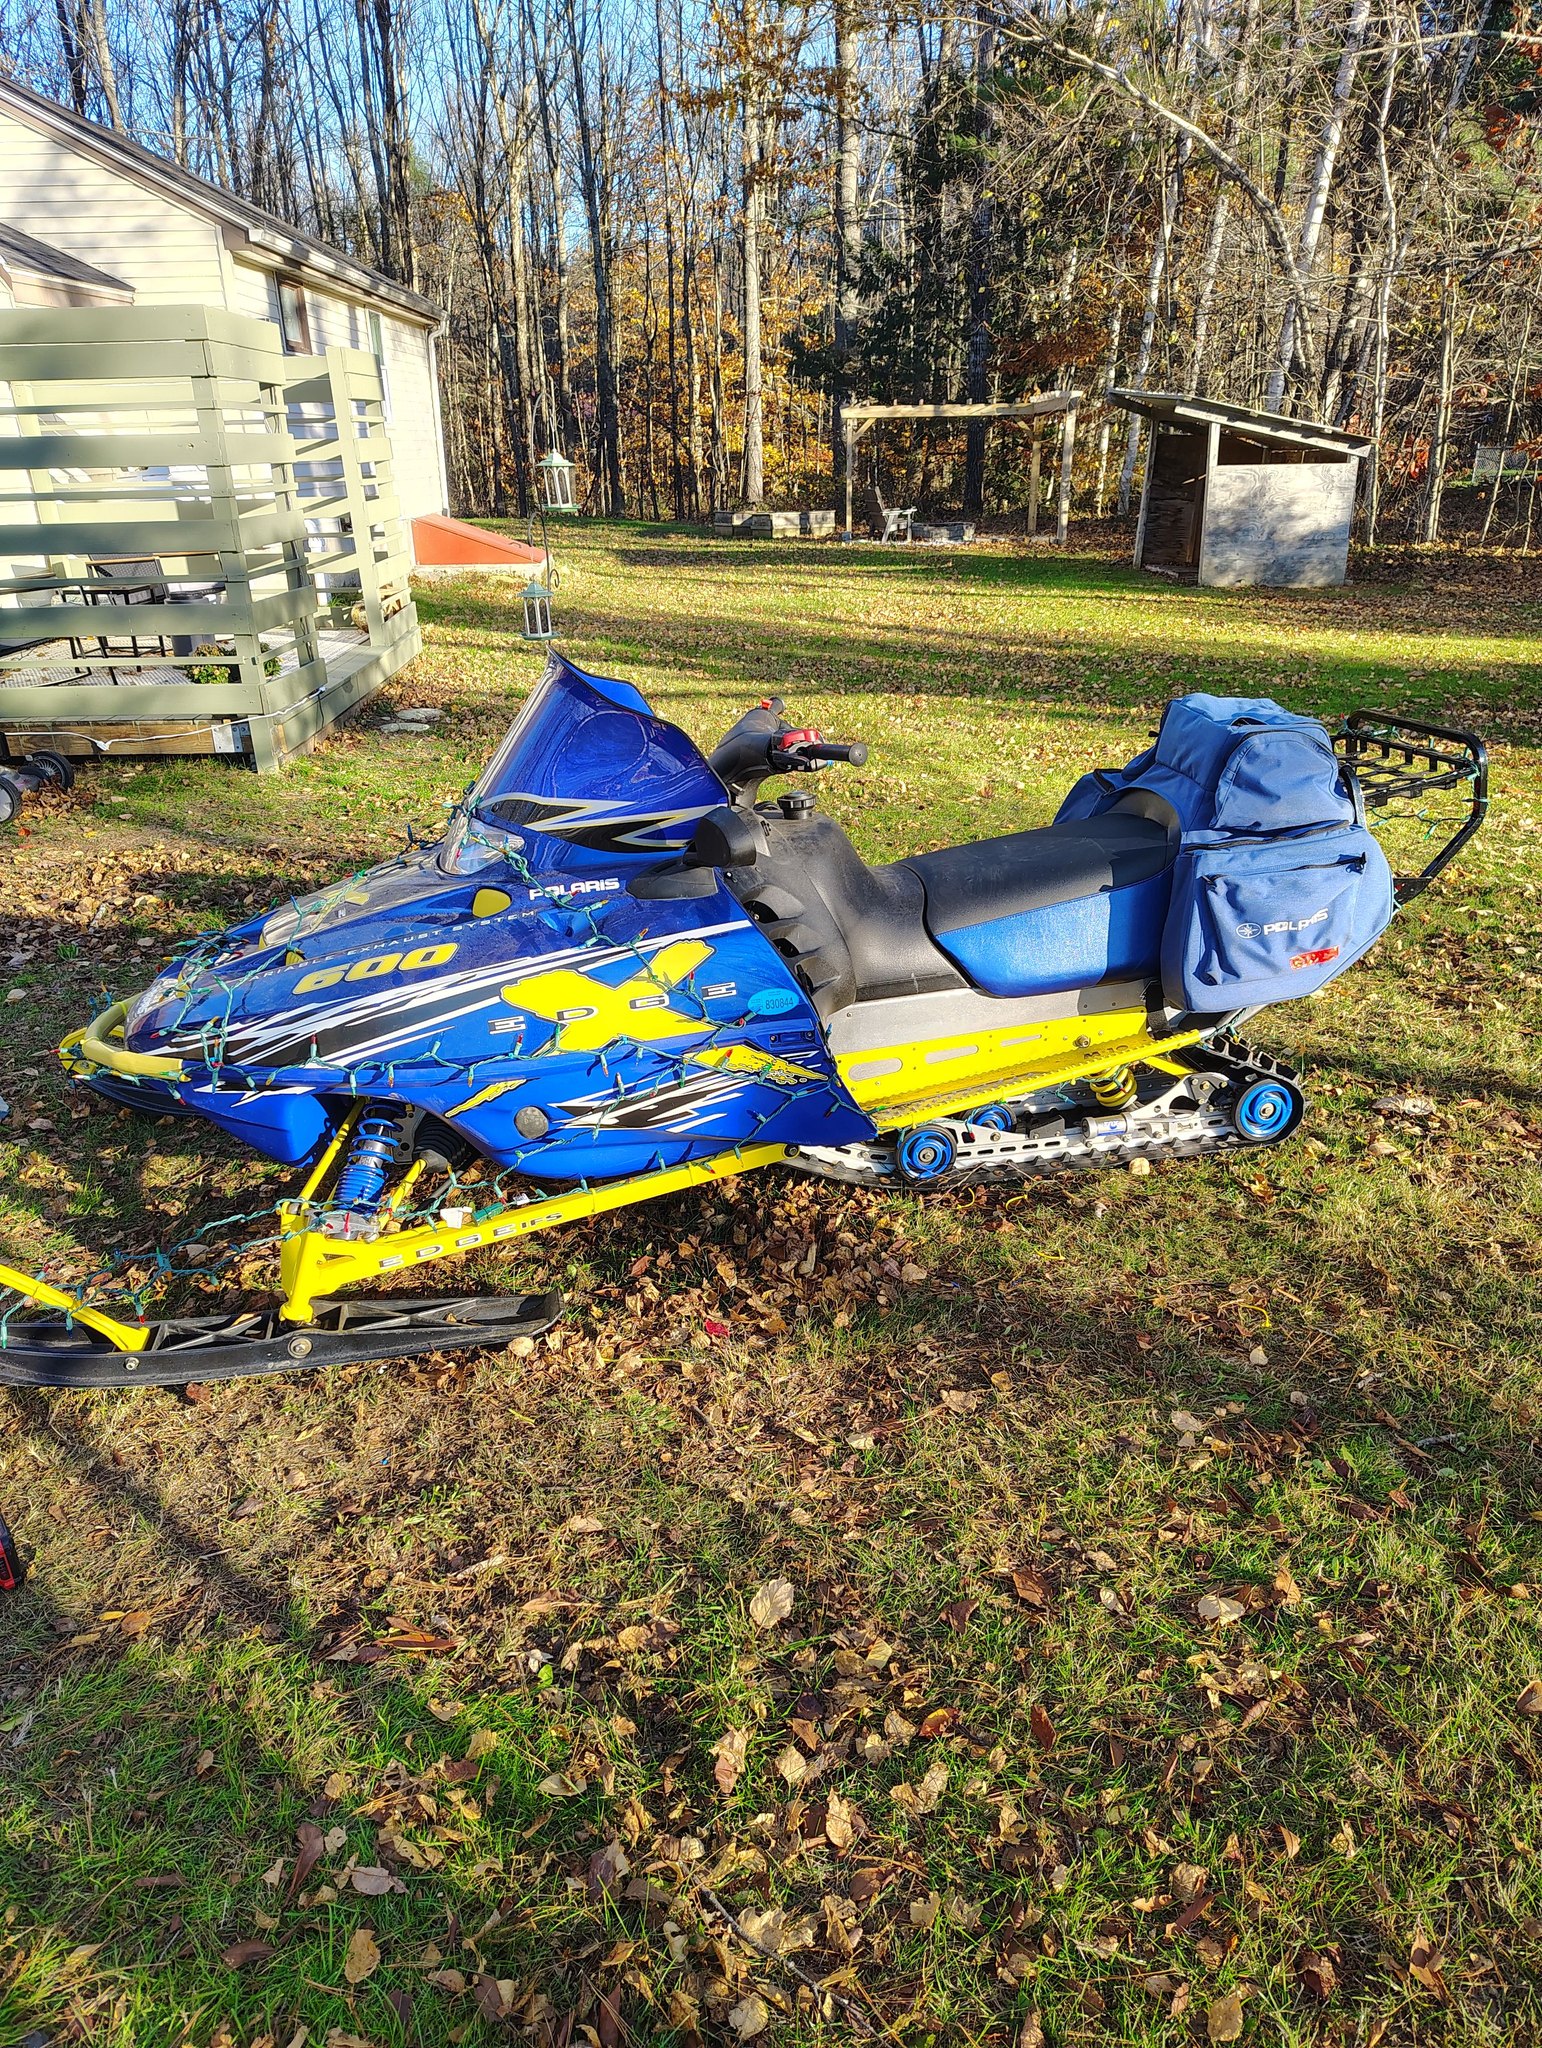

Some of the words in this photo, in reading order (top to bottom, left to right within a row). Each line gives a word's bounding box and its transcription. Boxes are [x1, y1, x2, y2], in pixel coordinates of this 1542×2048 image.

[529, 877, 620, 900] POLARIS
[347, 929, 443, 956] EXHAUST
[452, 910, 536, 932] SYSTEM
[1263, 908, 1329, 935] POLARIS
[292, 942, 460, 995] 600
[765, 996, 794, 1010] 830844
[520, 1211, 563, 1229] IFS
